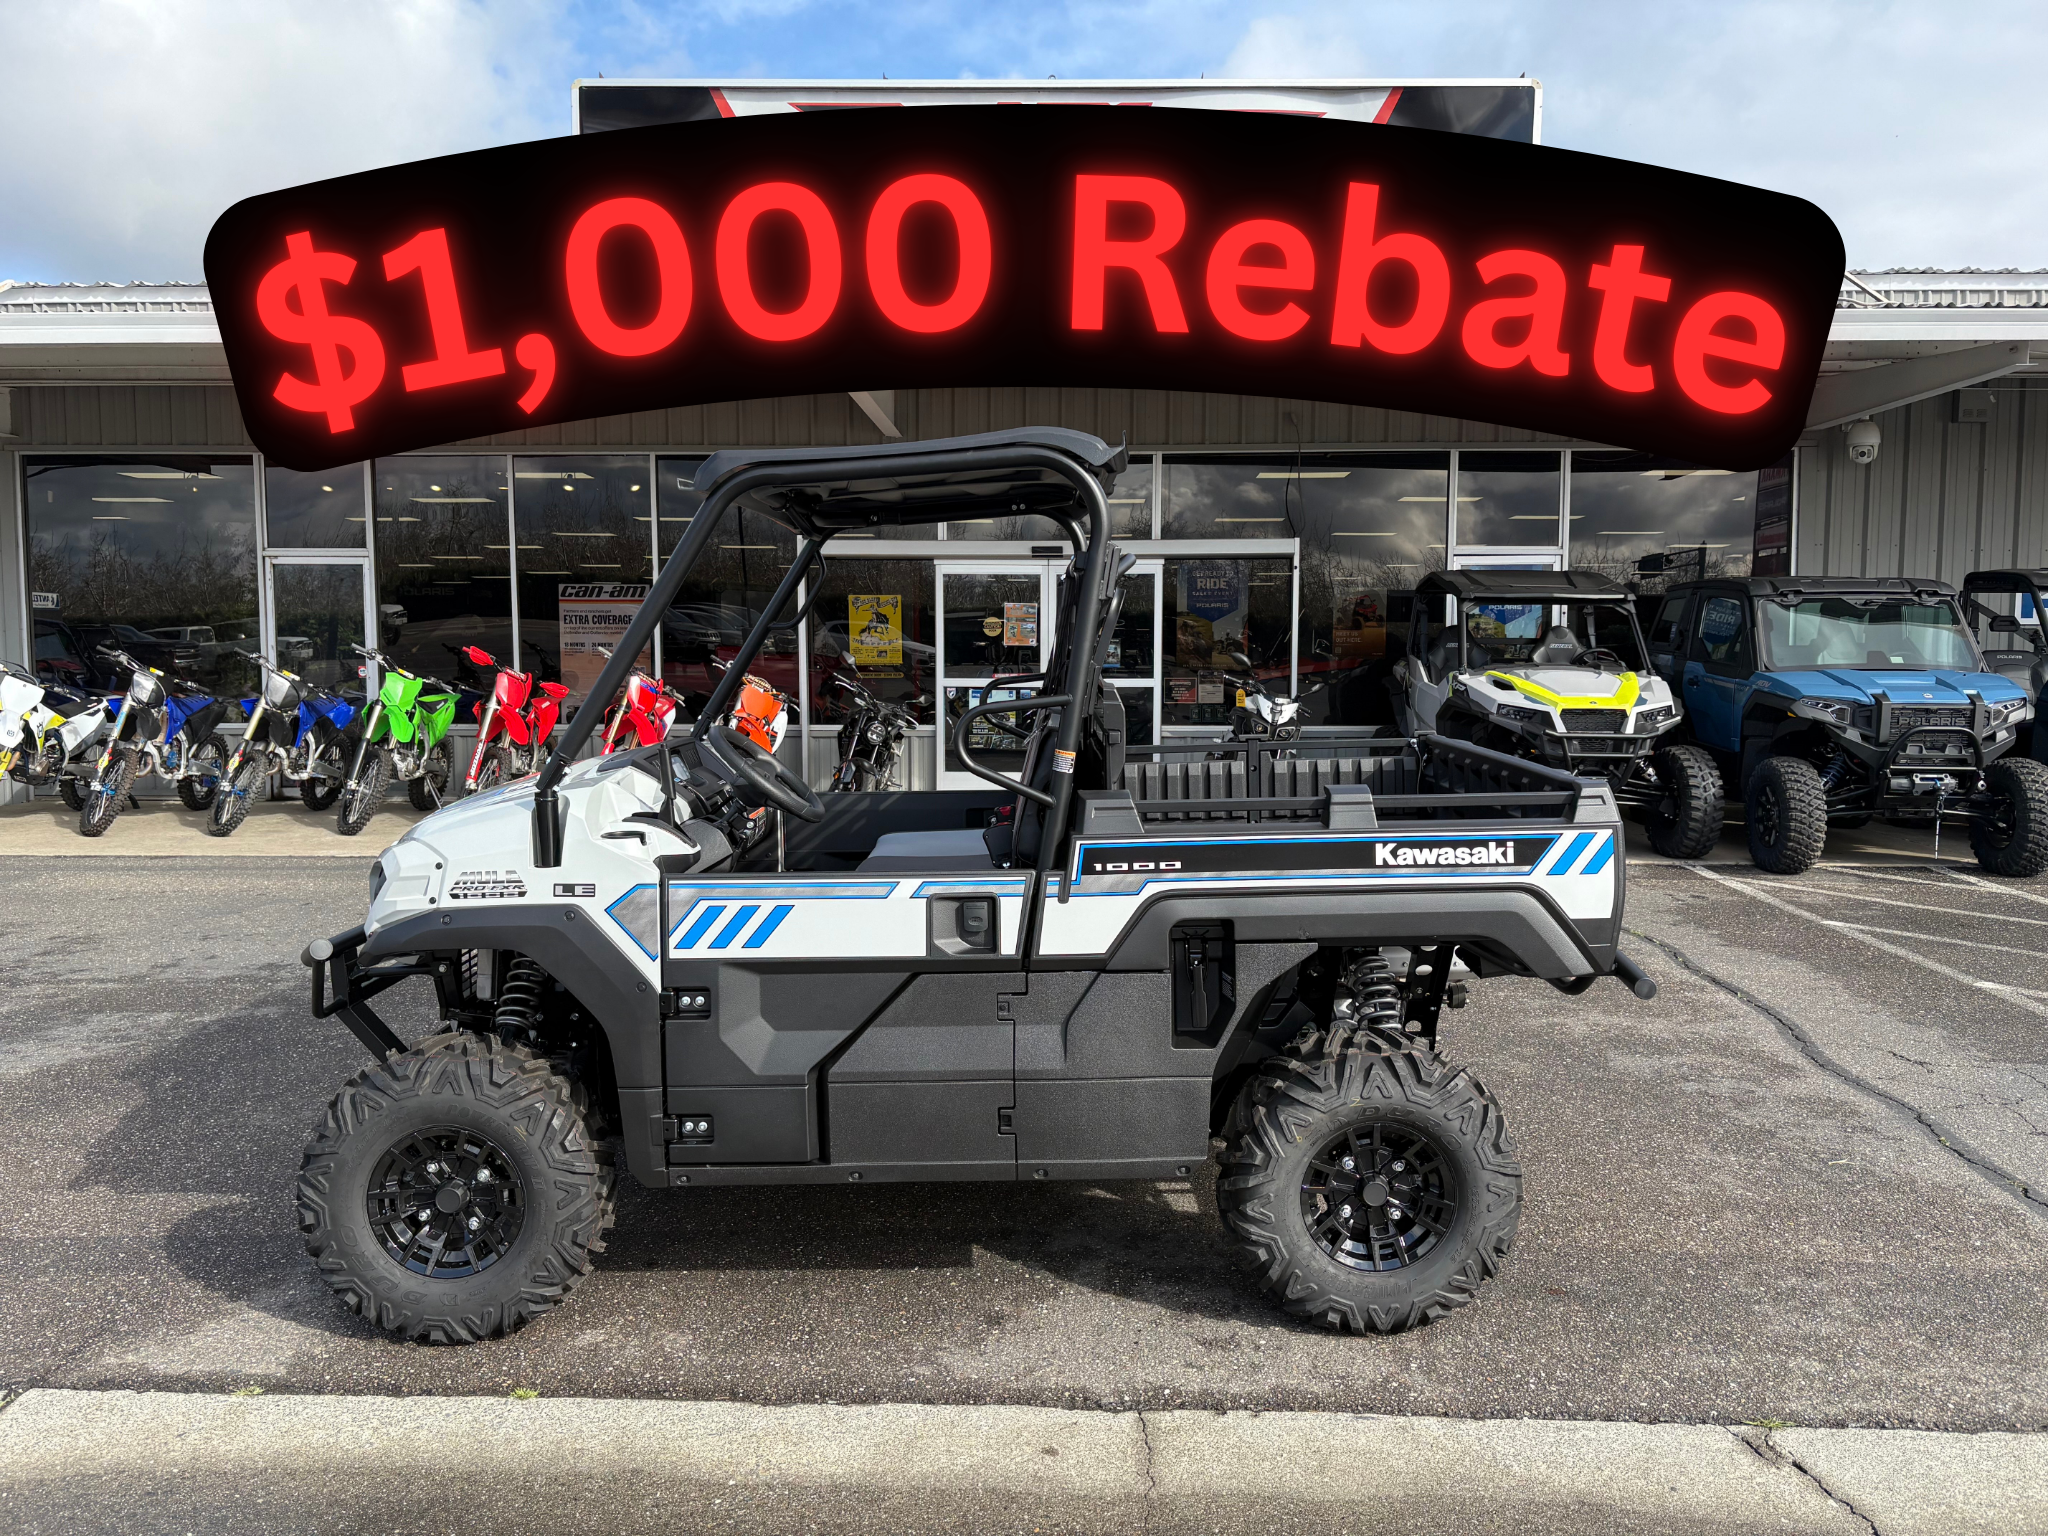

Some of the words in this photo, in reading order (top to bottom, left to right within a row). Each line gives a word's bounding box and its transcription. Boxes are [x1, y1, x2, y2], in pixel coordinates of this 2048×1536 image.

[1196, 578, 1229, 590] RIDE
[563, 614, 590, 624] EXTRA
[591, 614, 633, 624] COVERAGE
[1451, 679, 1467, 691] XP
[1755, 679, 1773, 689] ADV
[1898, 714, 1967, 726] POLARIS
[1375, 842, 1515, 866] Kawasaki
[1093, 861, 1182, 871] 1000
[453, 870, 524, 885] MULE
[554, 885, 596, 896] LE
